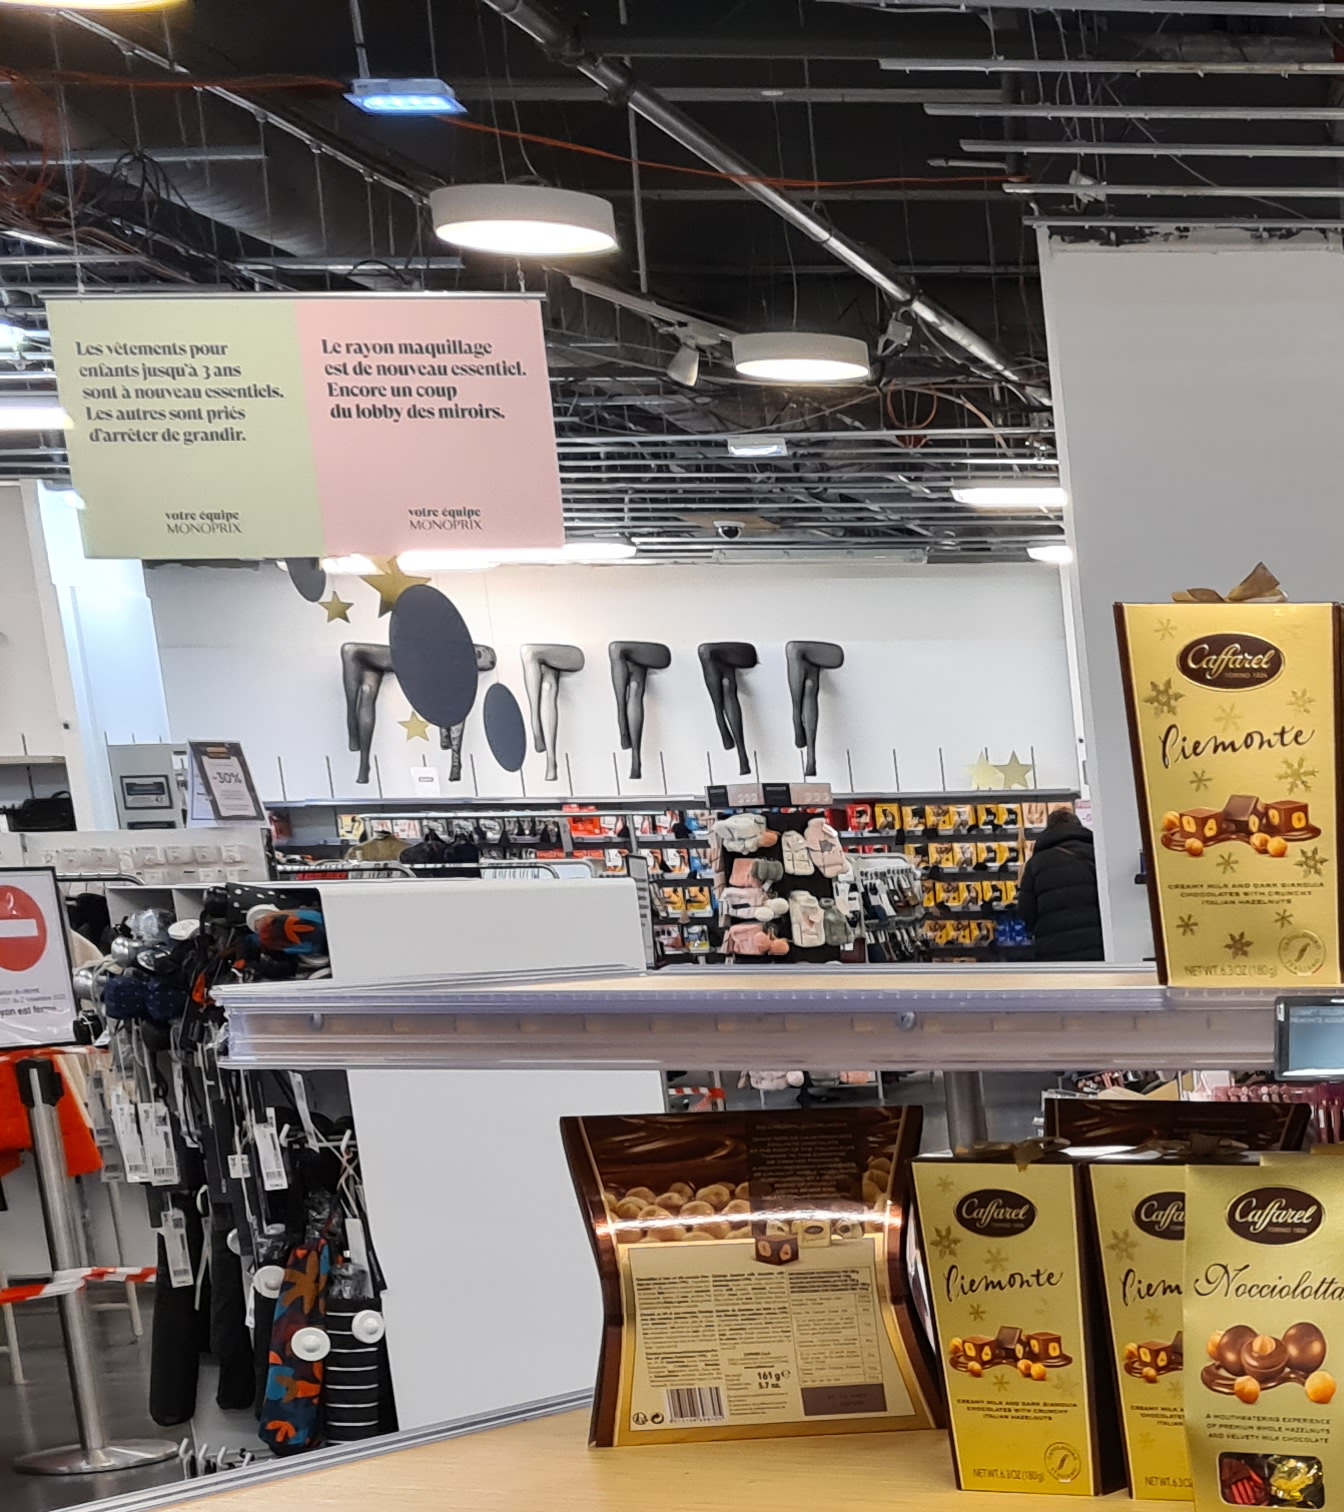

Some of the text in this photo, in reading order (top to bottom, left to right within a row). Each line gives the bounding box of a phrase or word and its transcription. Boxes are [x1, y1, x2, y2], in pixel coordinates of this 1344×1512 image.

[76, 339, 228, 359] Les vêtements pour
[322, 339, 492, 357] Le rayon maquillage
[80, 363, 139, 378] enfants
[203, 364, 210, 379] 3
[213, 365, 241, 378] ans
[325, 360, 526, 377] est de nouveau essentiel.
[83, 385, 284, 400] sont à nouveau essentiels.
[328, 383, 457, 401] Encore un coup
[86, 406, 245, 423] Les autres sont priés
[330, 404, 505, 423] du lobby des miroirs.
[90, 428, 246, 445] d'arrêter de grandir.
[200, 510, 239, 523] équipe
[408, 507, 481, 520] votre équipe
[167, 523, 242, 534] MONOPRIX
[410, 519, 482, 530] MONOPRIX
[1186, 644, 1276, 680] Caffarel
[1159, 723, 1317, 770] Piemonte
[961, 1198, 1030, 1228] Caffarel
[1234, 1197, 1315, 1236] Caffarel
[944, 1265, 1063, 1302] Piemonte
